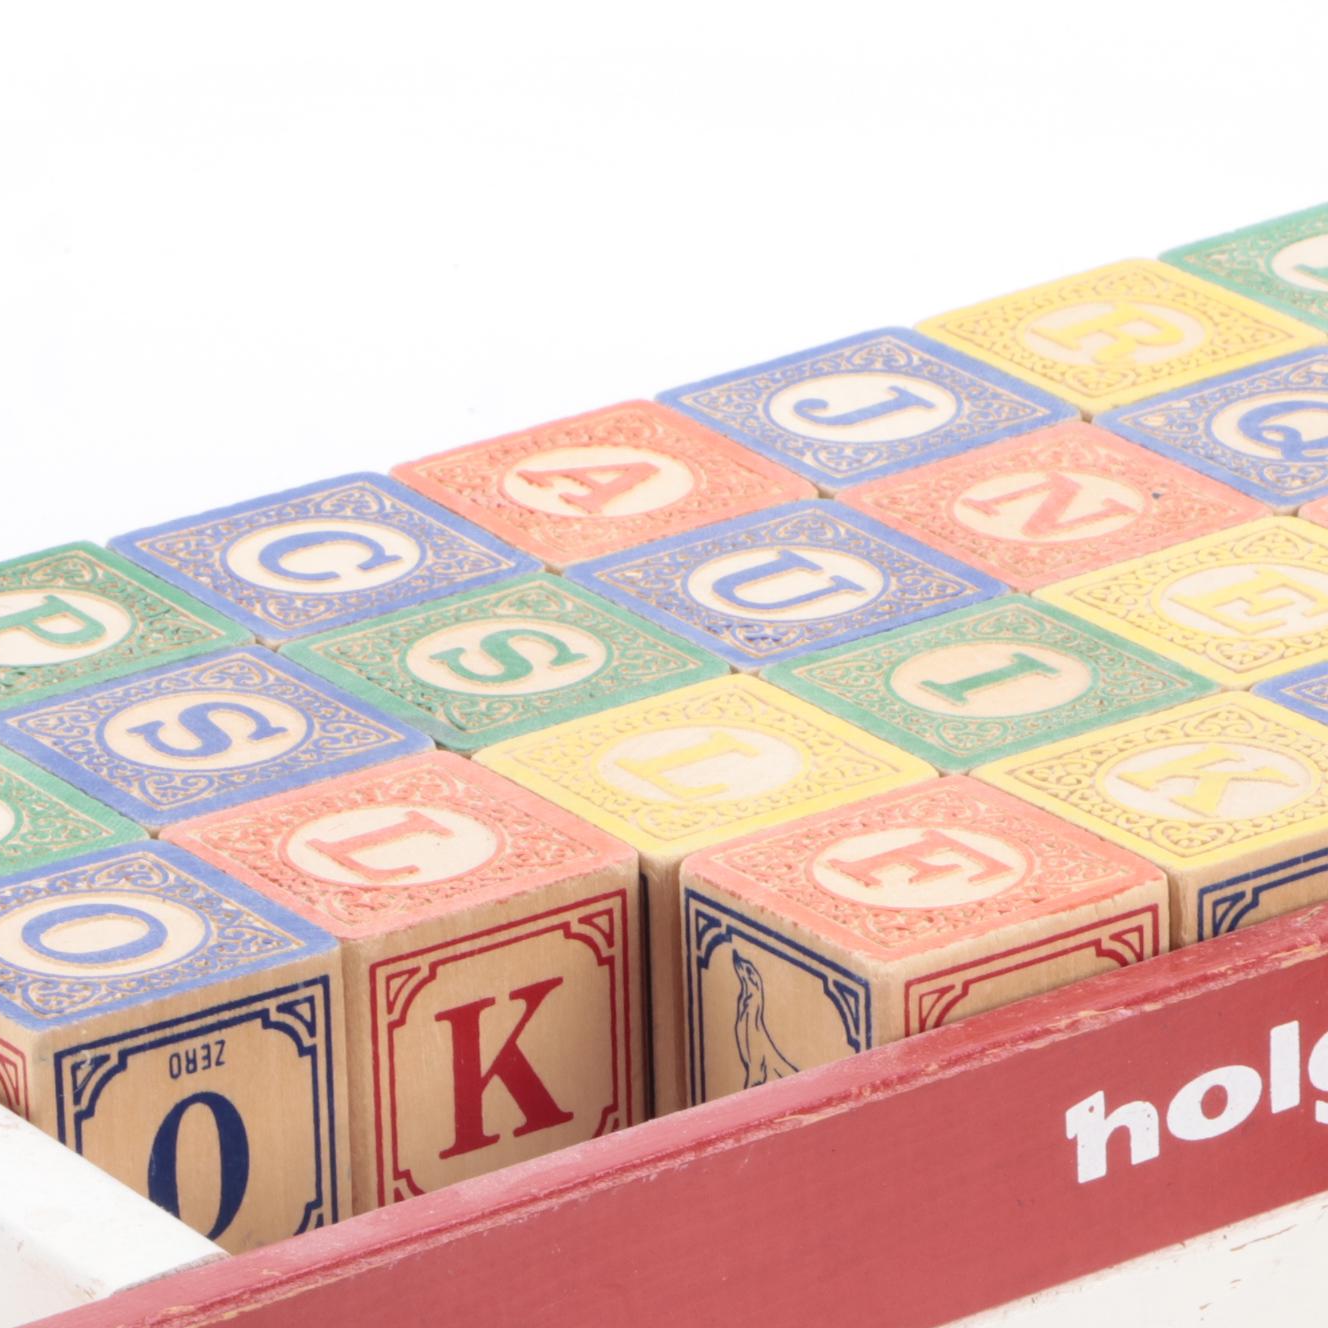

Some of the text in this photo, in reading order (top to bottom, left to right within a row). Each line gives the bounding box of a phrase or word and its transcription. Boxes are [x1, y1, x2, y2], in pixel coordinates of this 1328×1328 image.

[1045, 305, 1185, 364] R
[792, 386, 936, 425] J
[517, 461, 660, 513] A
[963, 473, 1138, 539] N
[258, 531, 403, 581] C
[711, 550, 866, 610] U
[430, 628, 588, 684] S
[920, 652, 1061, 705] I
[134, 702, 288, 759] S
[614, 731, 758, 796] L
[1118, 743, 1299, 818] K
[306, 811, 455, 880] L
[828, 829, 1012, 889] F
[21, 903, 168, 964] O
[169, 1039, 225, 1081] ZERO
[434, 976, 574, 1160] K
